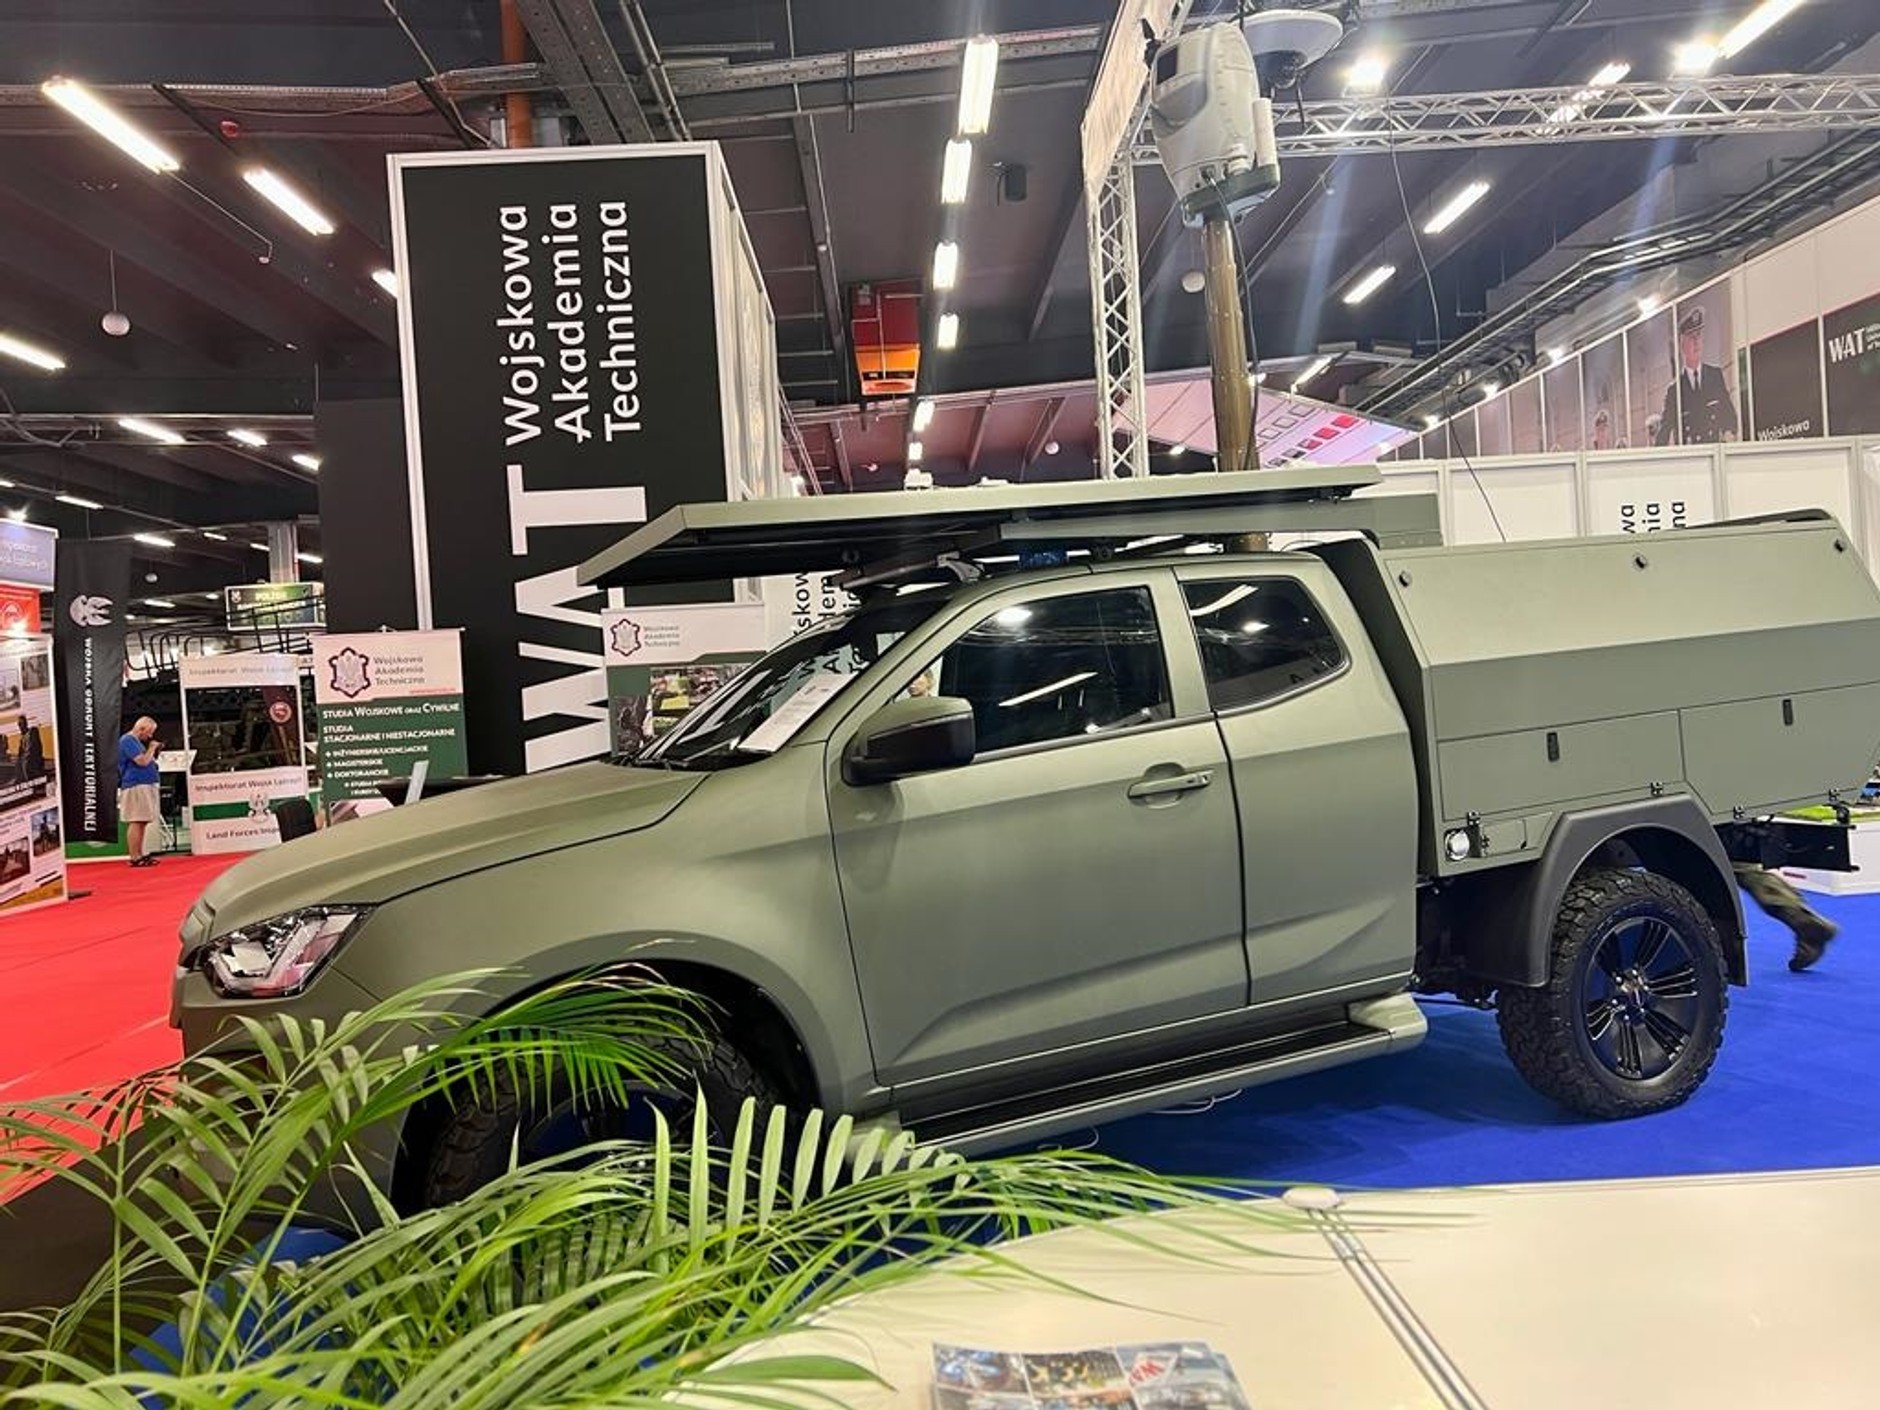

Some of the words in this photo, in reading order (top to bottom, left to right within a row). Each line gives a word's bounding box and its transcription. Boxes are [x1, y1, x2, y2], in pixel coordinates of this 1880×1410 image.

[496, 205, 545, 446] Wojskowa
[541, 204, 592, 444] Akademia
[596, 201, 641, 442] Techniczna
[1828, 327, 1866, 363] WAT
[1757, 419, 1810, 441] Wojskowa
[373, 656, 423, 666] Wojskowa
[375, 666, 424, 675] Akademia
[376, 676, 425, 686] Techniczna
[322, 709, 353, 719] STUDIA
[354, 706, 403, 718] WOJSKOWE
[422, 703, 460, 714] CYWILNE
[323, 725, 353, 734] STUDIA
[323, 732, 381, 743] STACJONARNE
[386, 728, 456, 740] NIESTACJONARNE
[206, 830, 228, 840] Land
[230, 828, 259, 838] Forces
